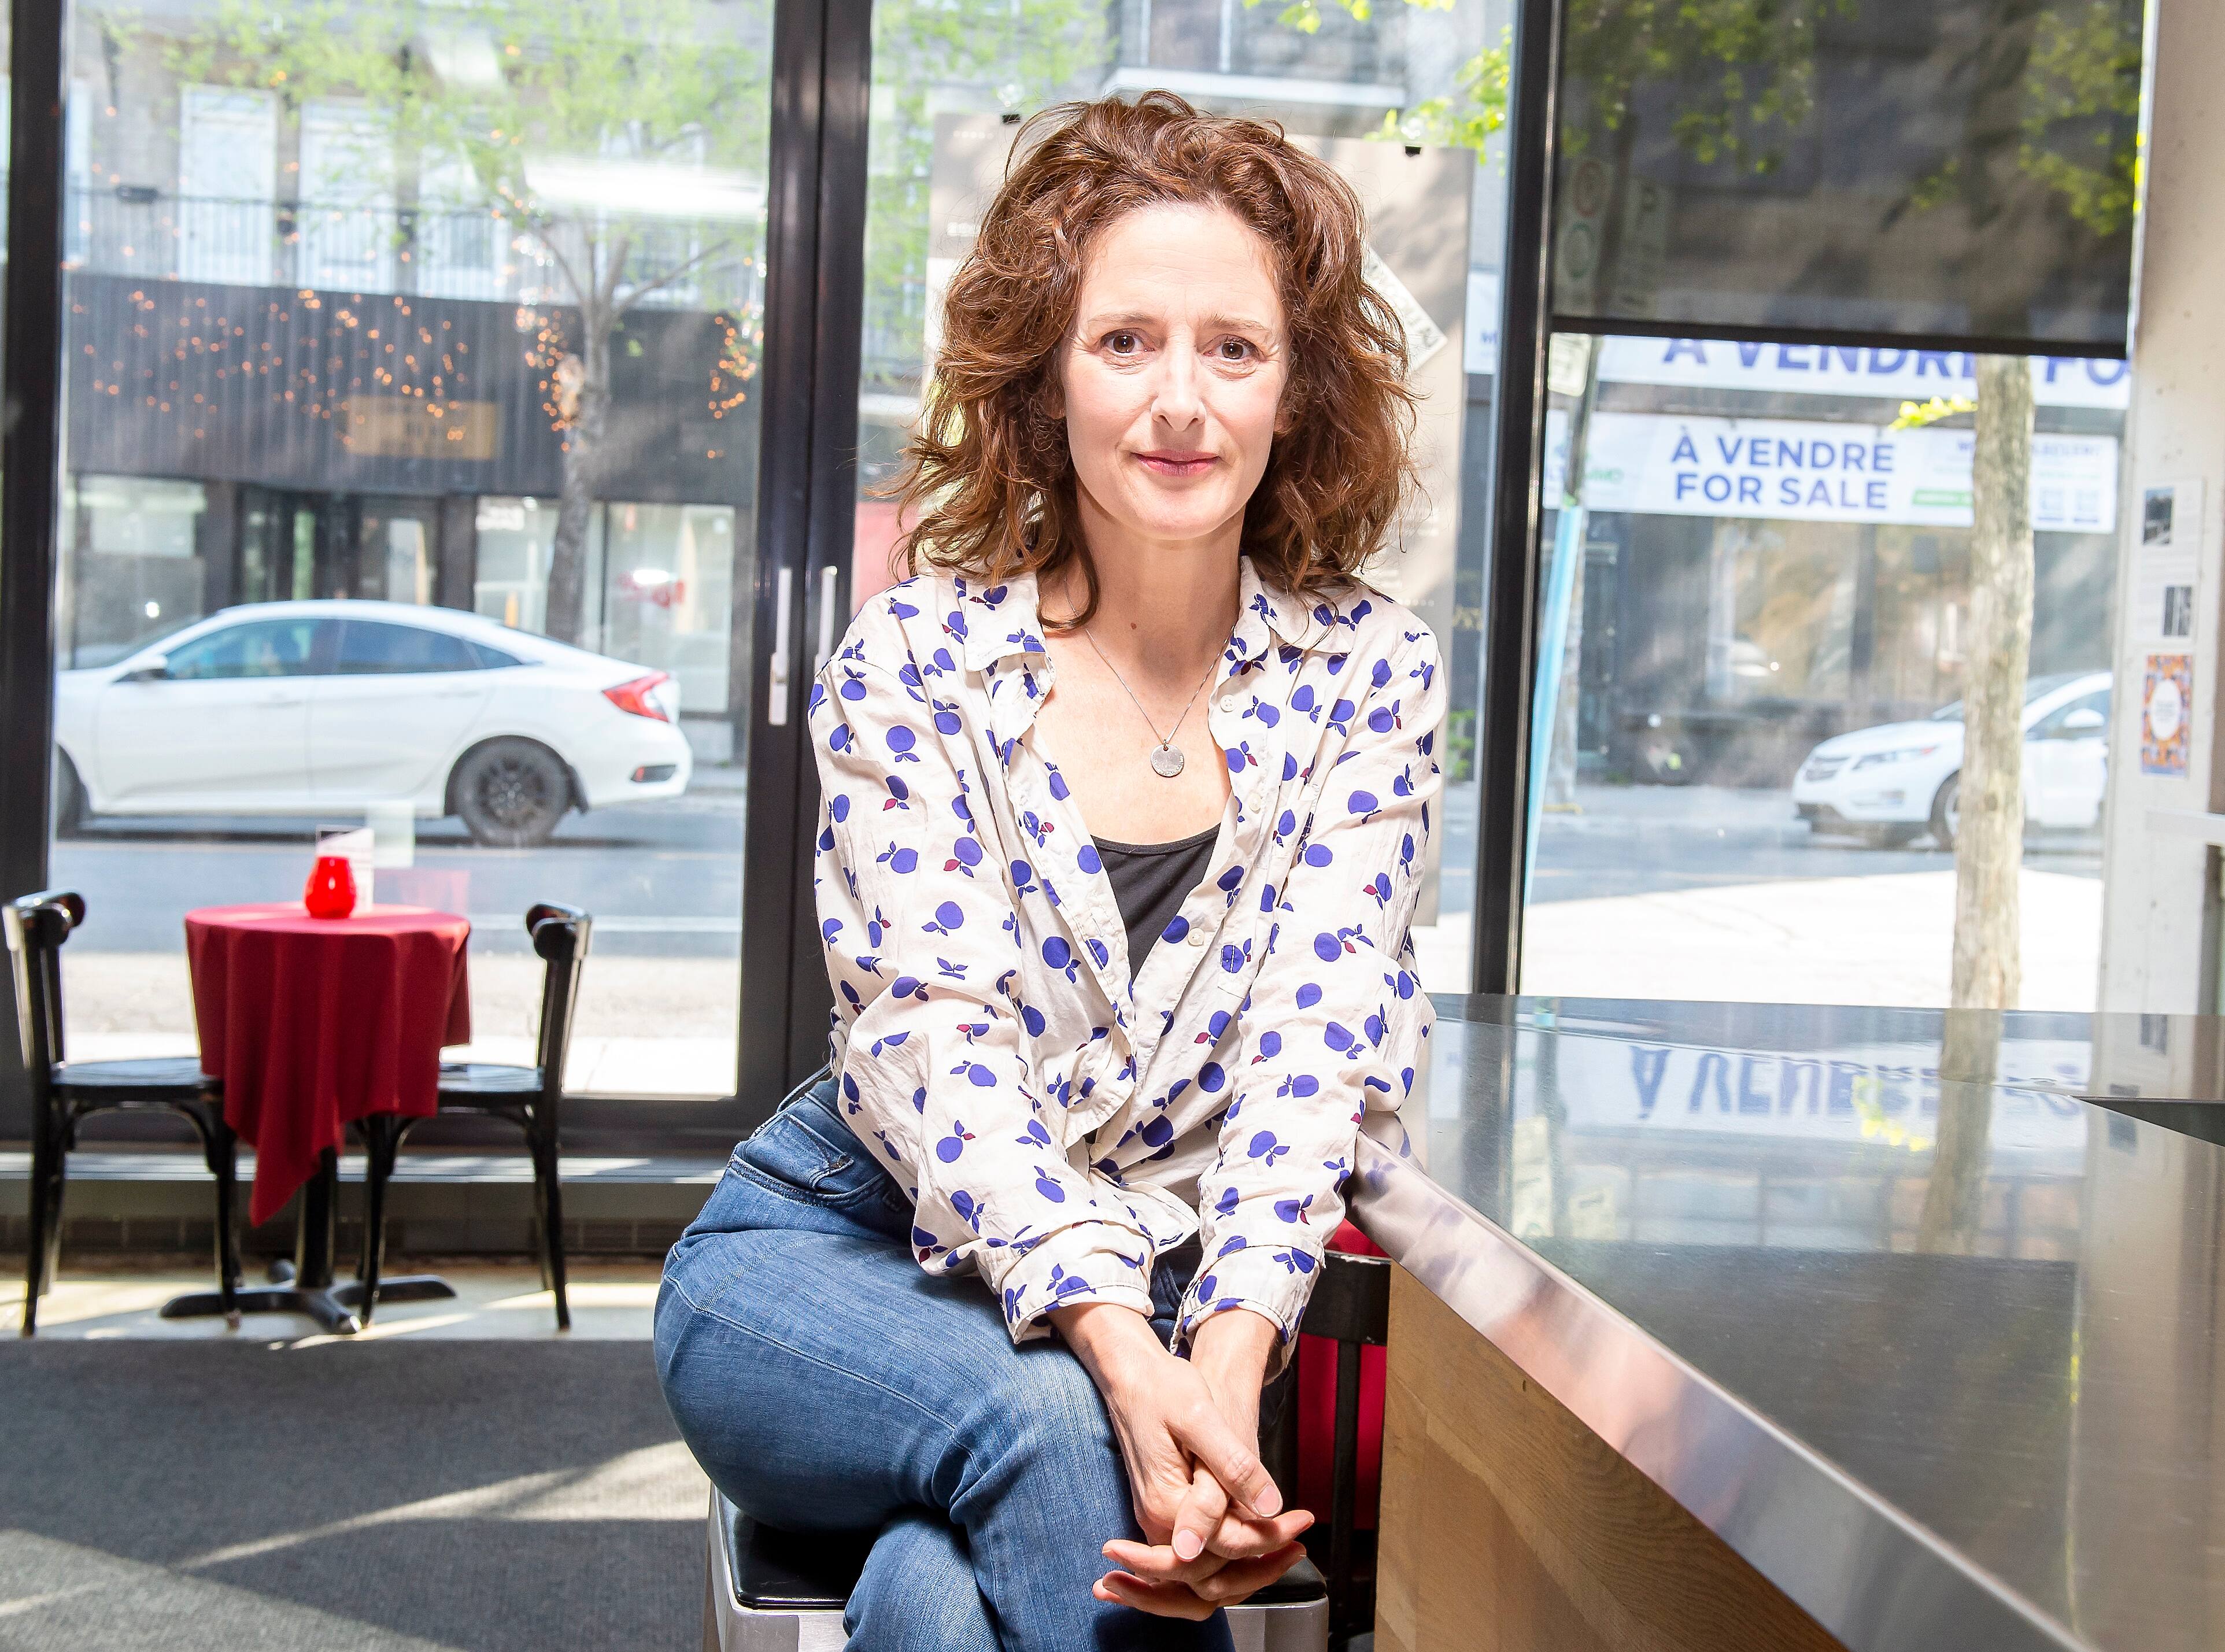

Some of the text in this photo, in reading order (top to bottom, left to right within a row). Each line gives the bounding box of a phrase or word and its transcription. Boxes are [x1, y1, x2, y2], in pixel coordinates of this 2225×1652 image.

[1671, 425, 1895, 472] À VENDRE
[1675, 473, 1761, 504] FOR
[1780, 477, 1887, 509] SALE
